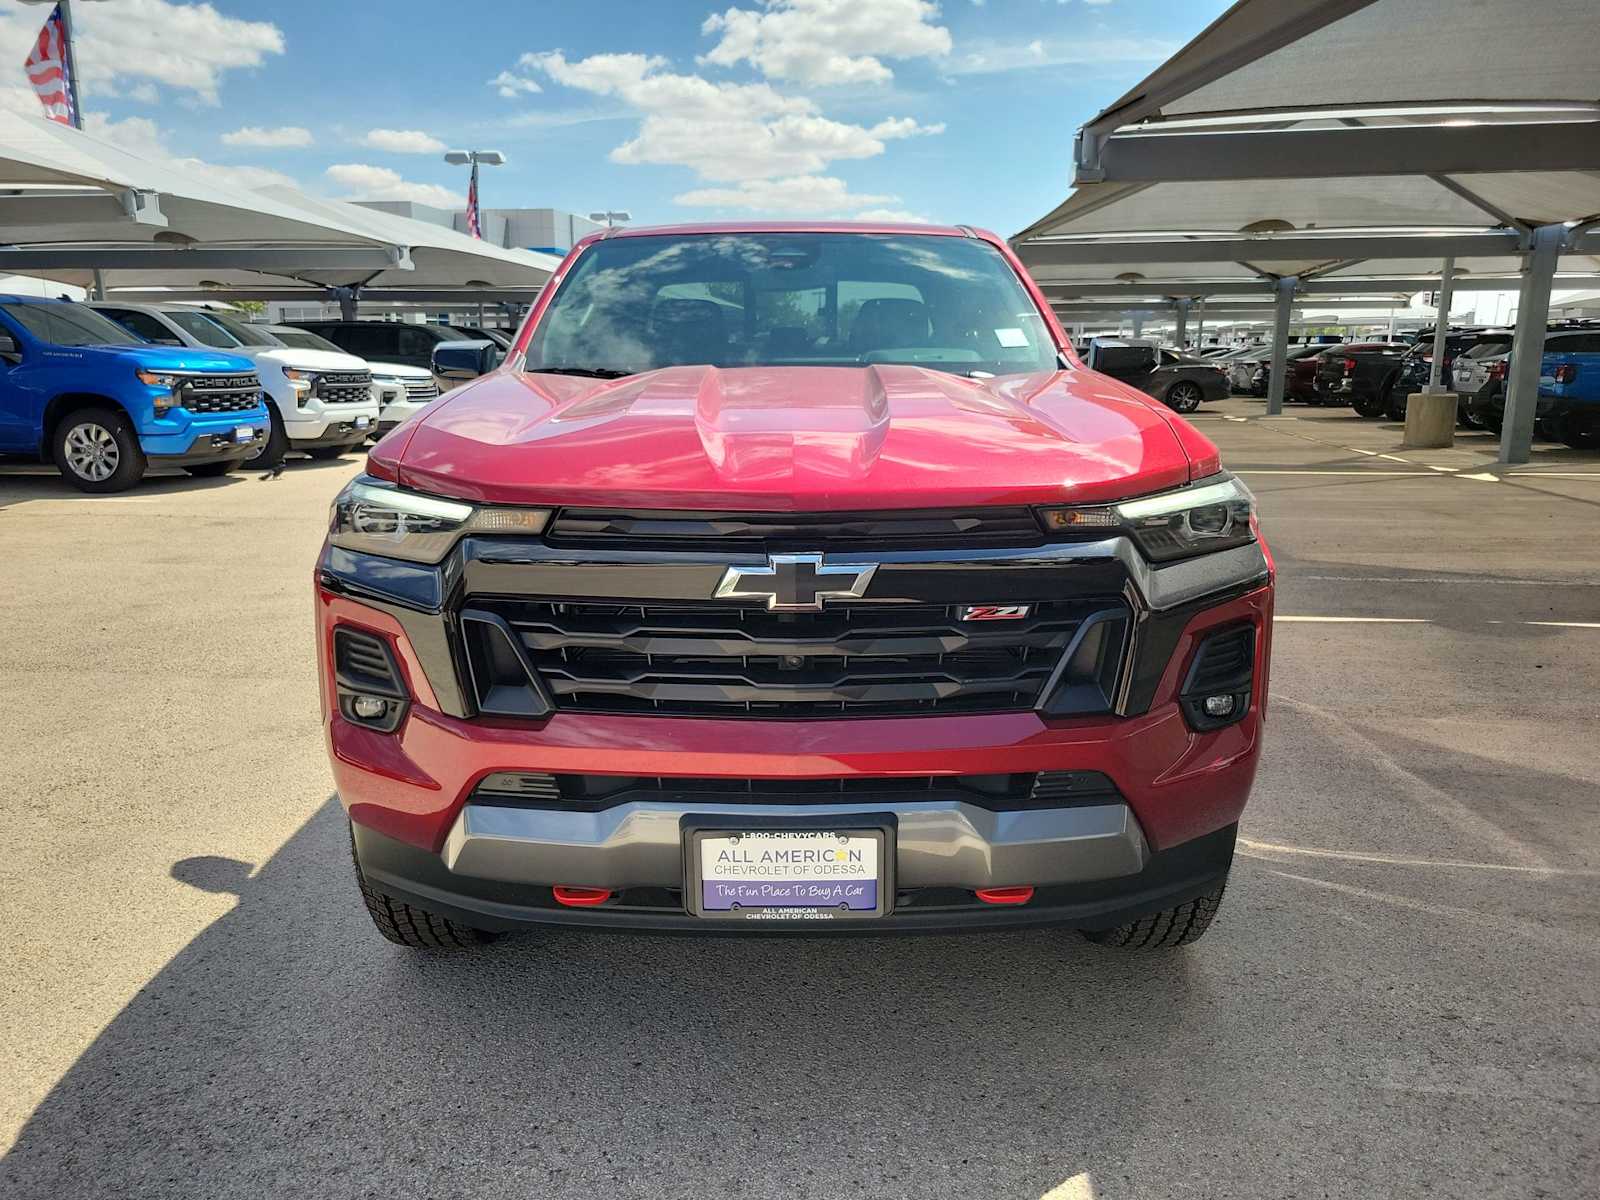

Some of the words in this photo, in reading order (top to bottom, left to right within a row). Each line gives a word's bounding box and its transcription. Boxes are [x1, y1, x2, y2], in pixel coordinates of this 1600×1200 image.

[963, 606, 1029, 621] Z71
[718, 849, 754, 863] ALL
[760, 848, 862, 863] AMERICN
[714, 864, 789, 876] CHEVROLET
[793, 864, 811, 875] OF
[814, 864, 866, 875] ODESSA
[716, 884, 736, 897] The
[738, 885, 759, 897] Fun
[761, 884, 791, 897] Place
[793, 884, 806, 897] To
[808, 884, 831, 900] Buy
[833, 884, 842, 897] A
[845, 884, 864, 897] Car
